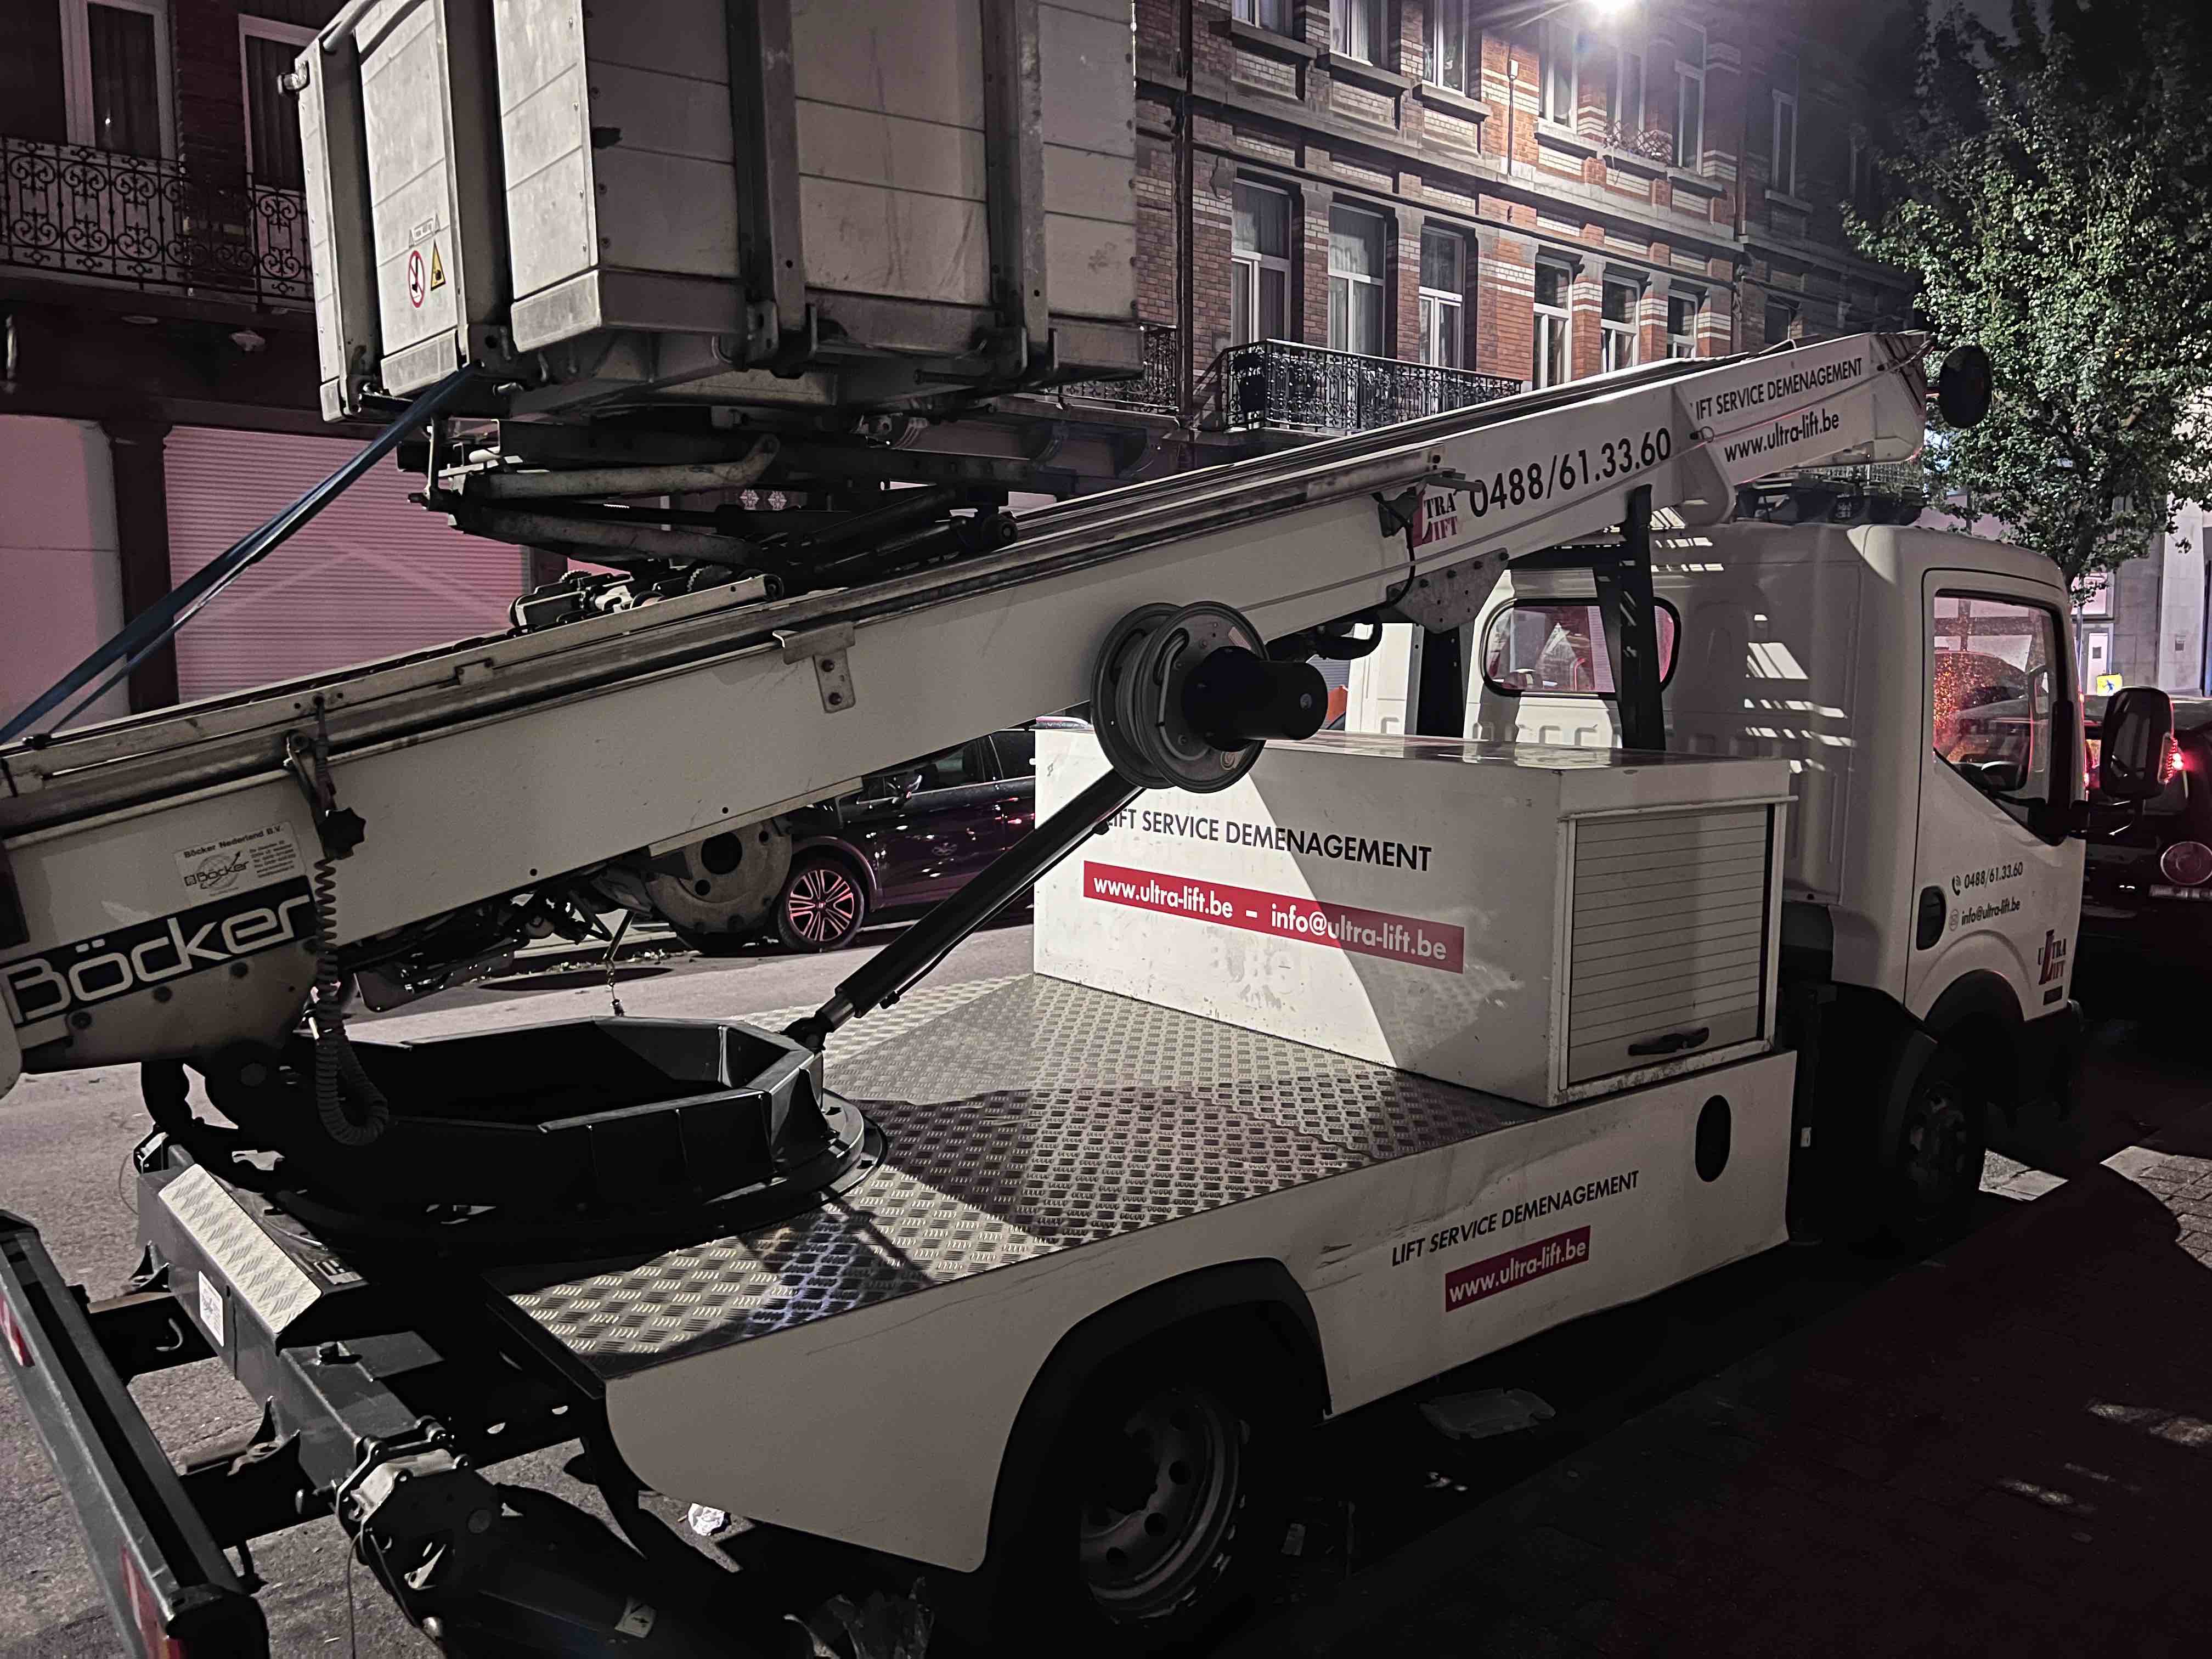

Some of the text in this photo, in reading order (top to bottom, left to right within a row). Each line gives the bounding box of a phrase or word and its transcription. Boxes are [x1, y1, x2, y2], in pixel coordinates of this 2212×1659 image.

[1716, 385, 1764, 414] SERVICE
[1768, 358, 1862, 400] DEMENAGEMENT
[1725, 409, 1839, 462] www.ultra-lift.be
[1470, 428, 1671, 517] 0488/61.33.60
[184, 845, 216, 858] Böcker
[219, 831, 264, 849] Nederland
[1142, 810, 1218, 841] SERVICE
[1226, 821, 1431, 871] DEMENAGEMENT
[198, 861, 249, 883] Böcker
[1965, 862, 2023, 888] 0488/61.33.60
[1093, 876, 1233, 918] www.ultra-lift.be
[1271, 903, 1446, 961] info@ultra-lift.be
[1962, 897, 2020, 926] info@ultra-lift.be
[1, 894, 309, 1025] Böcker
[1392, 1170, 1639, 1266] LIFT SERVICE DEMENAGEMENT
[1449, 1239, 1585, 1302] www.ultra-lift.be
